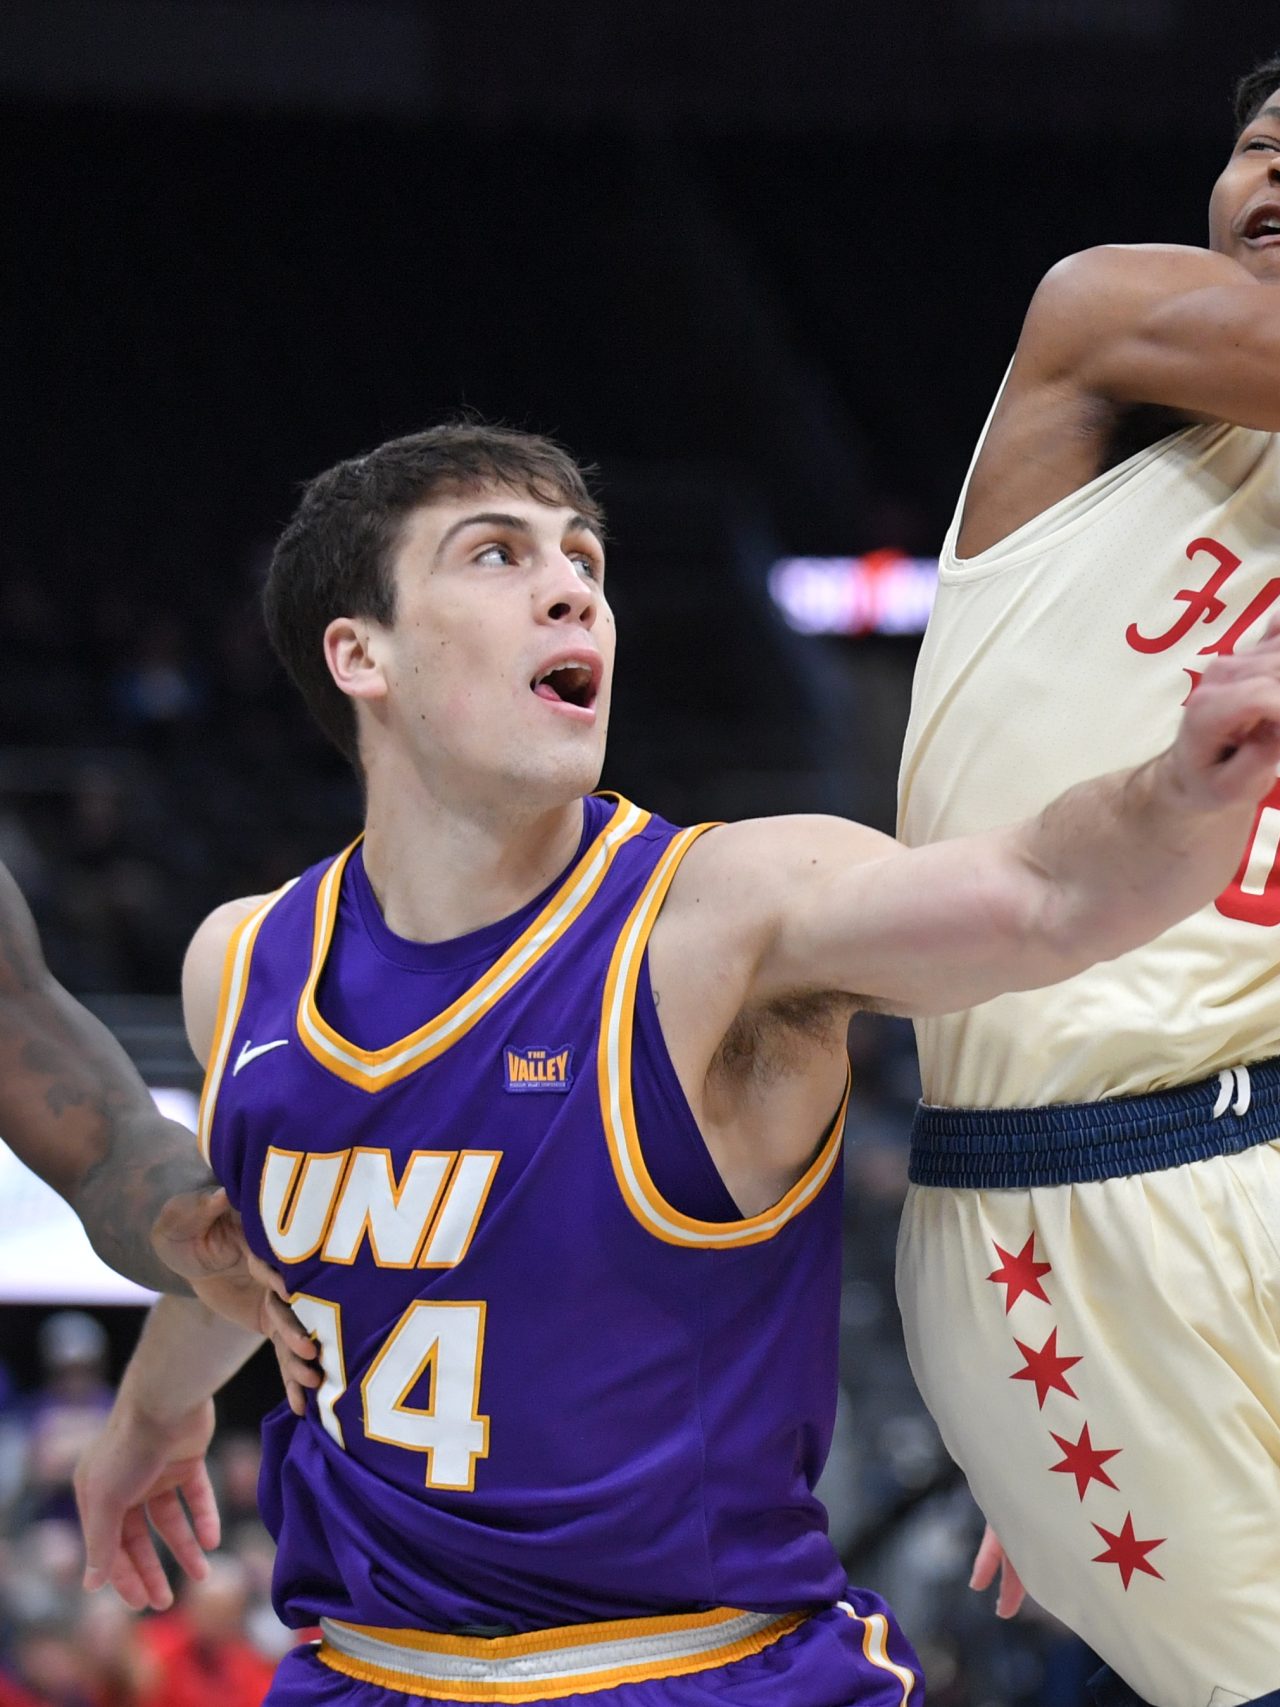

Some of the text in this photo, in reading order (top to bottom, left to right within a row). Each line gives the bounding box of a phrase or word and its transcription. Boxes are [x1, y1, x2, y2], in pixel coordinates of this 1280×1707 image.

[507, 1050, 570, 1082] VALLEY
[527, 1050, 546, 1060] THE
[258, 1145, 504, 1270] UNI
